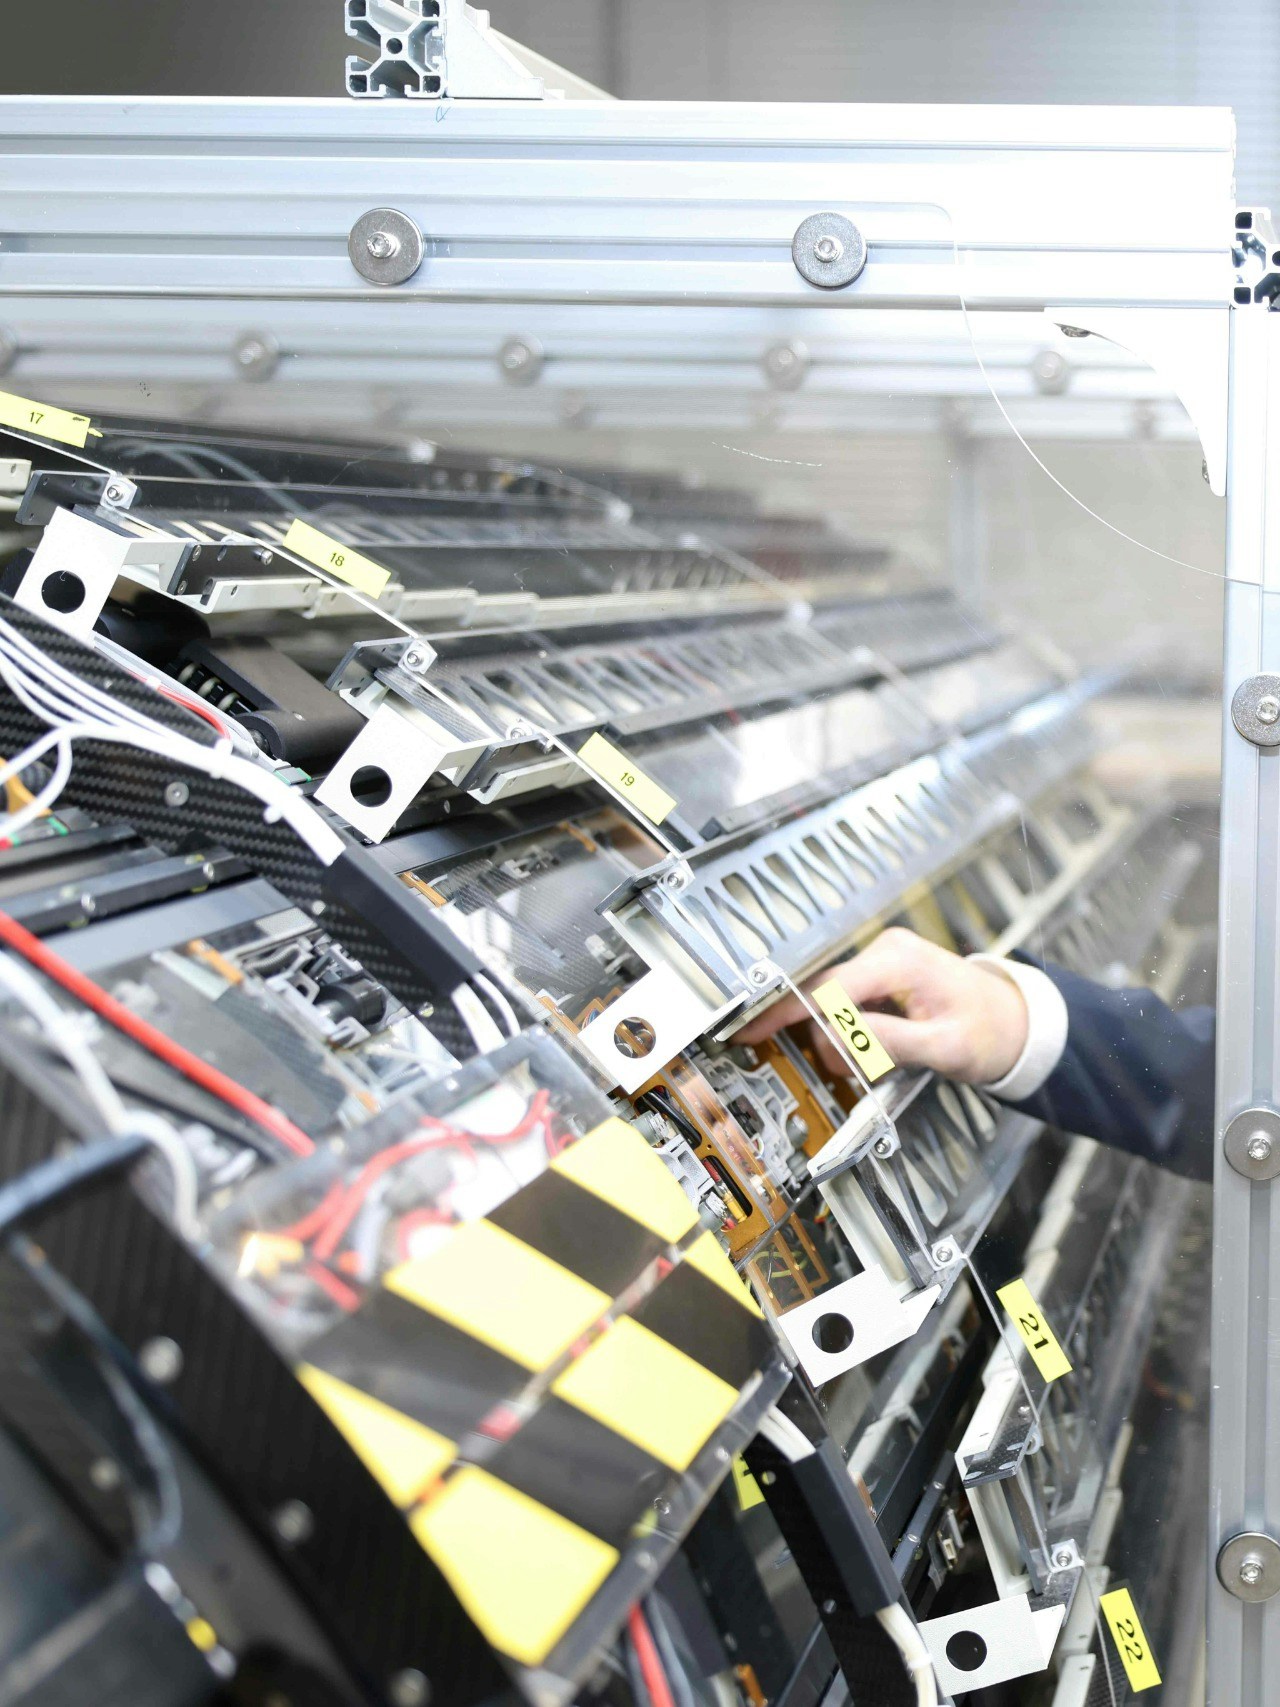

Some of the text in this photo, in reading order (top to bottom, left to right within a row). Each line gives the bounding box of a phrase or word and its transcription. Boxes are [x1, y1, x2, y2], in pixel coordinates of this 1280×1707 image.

[29, 411, 44, 424] 17
[330, 552, 345, 567] 18
[620, 772, 635, 787] 19
[834, 1008, 871, 1053] 20
[1018, 1312, 1050, 1350] 21
[1115, 1617, 1144, 1664] 22
